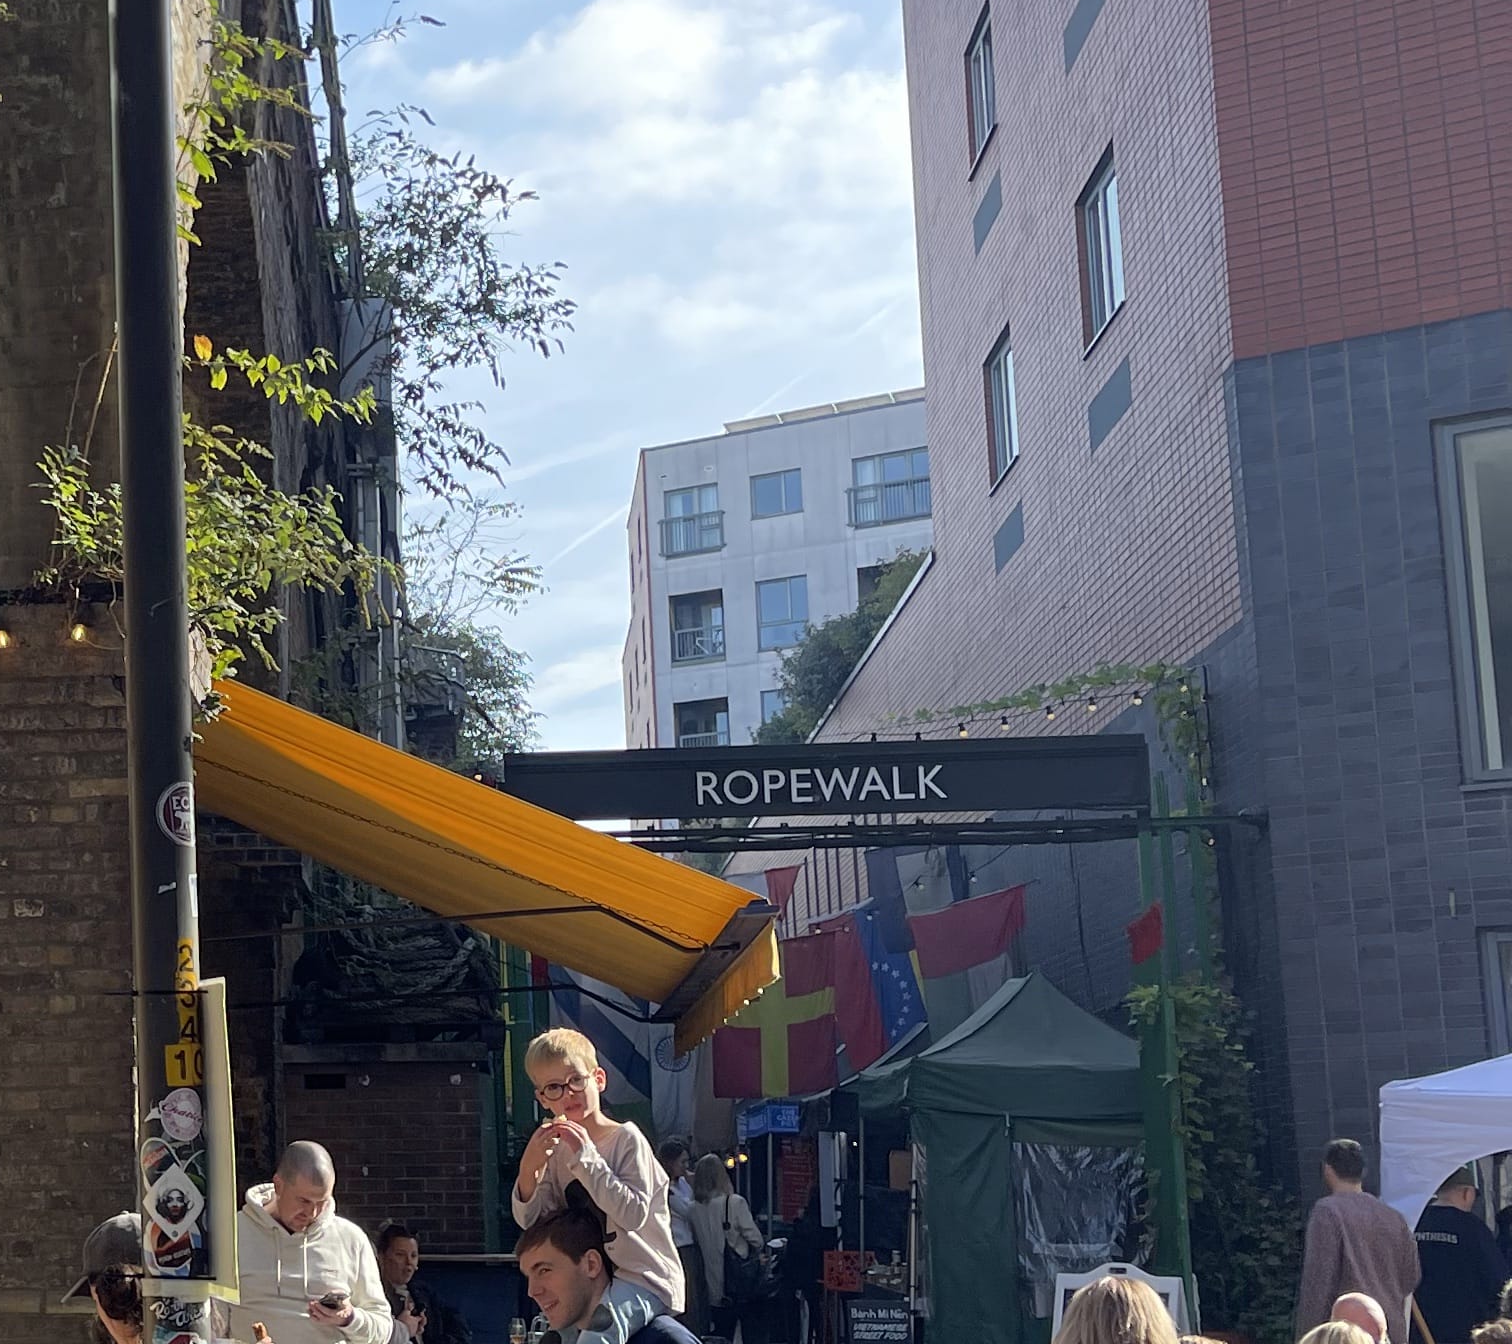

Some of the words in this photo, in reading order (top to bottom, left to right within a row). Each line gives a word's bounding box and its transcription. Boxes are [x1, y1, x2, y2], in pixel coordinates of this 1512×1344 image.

[695, 764, 949, 806] ROPEWALK
[853, 1323, 908, 1332] VIETNAMESE
[853, 1331, 884, 1340] STREET
[884, 1331, 908, 1341] FOOD
